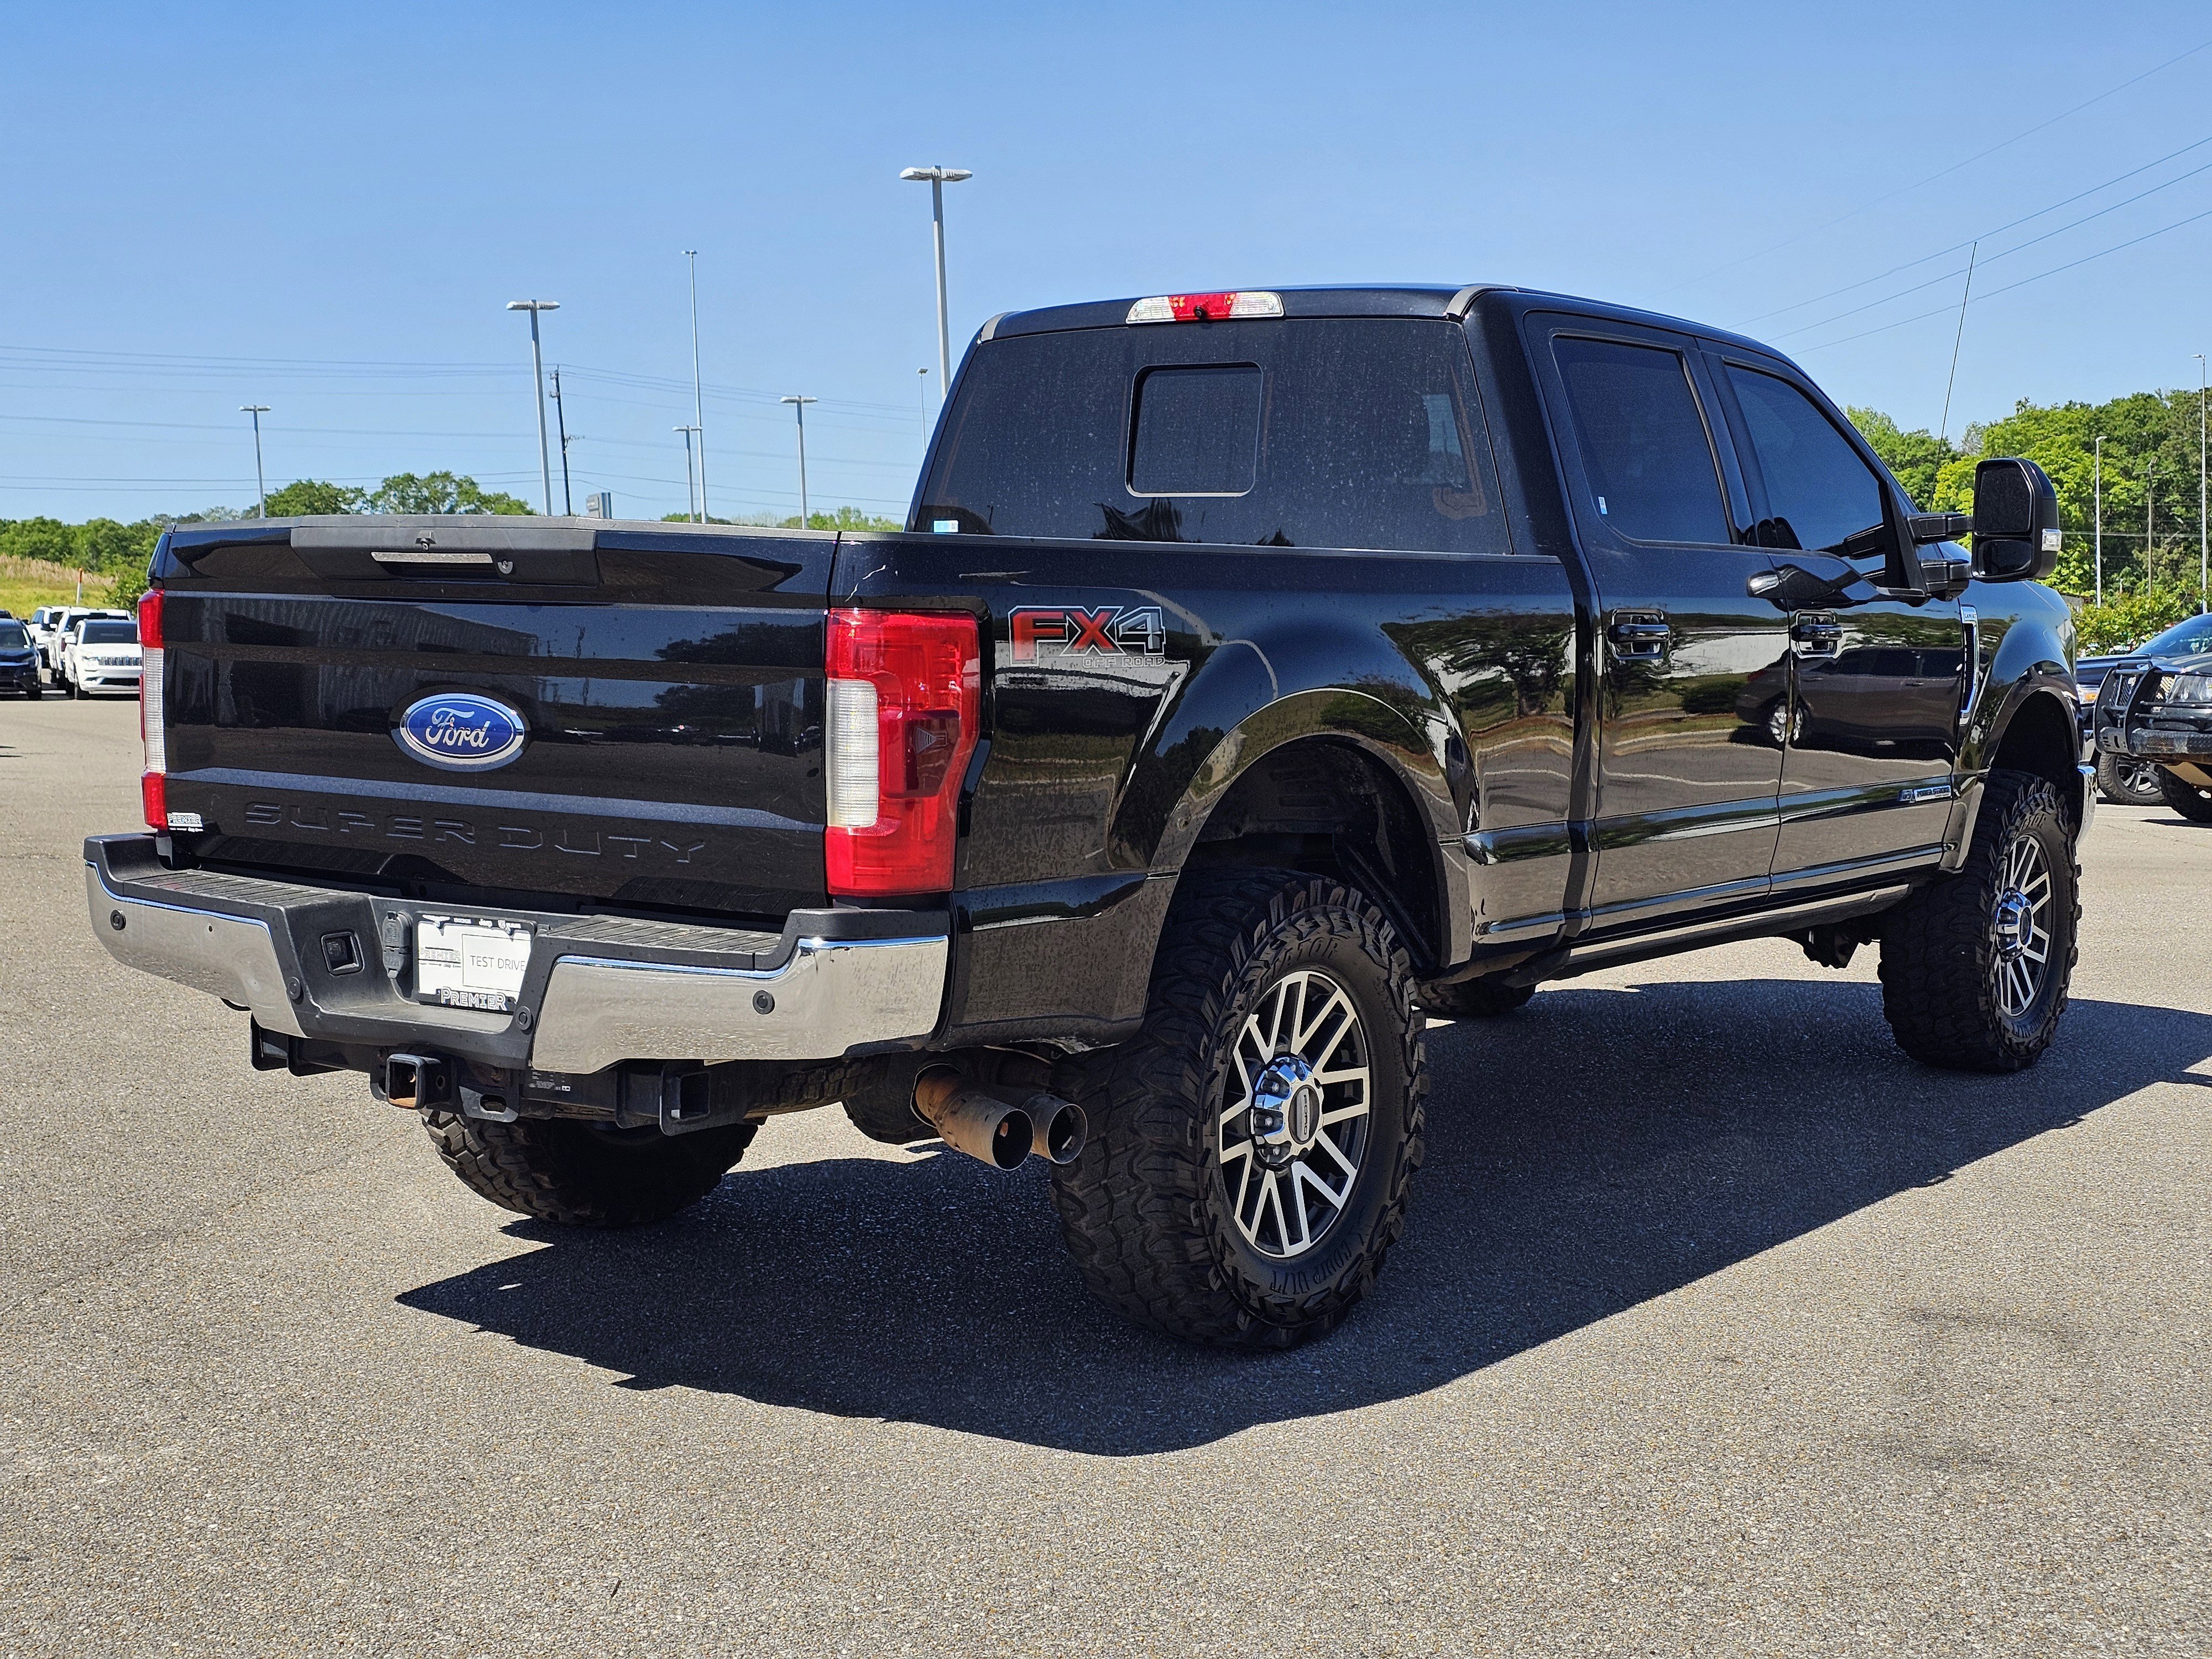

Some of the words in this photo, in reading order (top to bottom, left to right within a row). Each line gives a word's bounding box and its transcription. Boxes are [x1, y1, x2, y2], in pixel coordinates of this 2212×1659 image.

[1007, 605, 1166, 667] FX4
[1082, 656, 1117, 668] OFF
[1121, 656, 1166, 667] ROAD
[425, 707, 489, 748] Ford
[245, 801, 476, 845] SUPER
[498, 825, 705, 864] DUTY
[419, 947, 461, 961] PREMIER
[470, 955, 495, 968] TEST
[497, 958, 526, 972] DRIVE
[440, 986, 508, 1011] PREMIER
